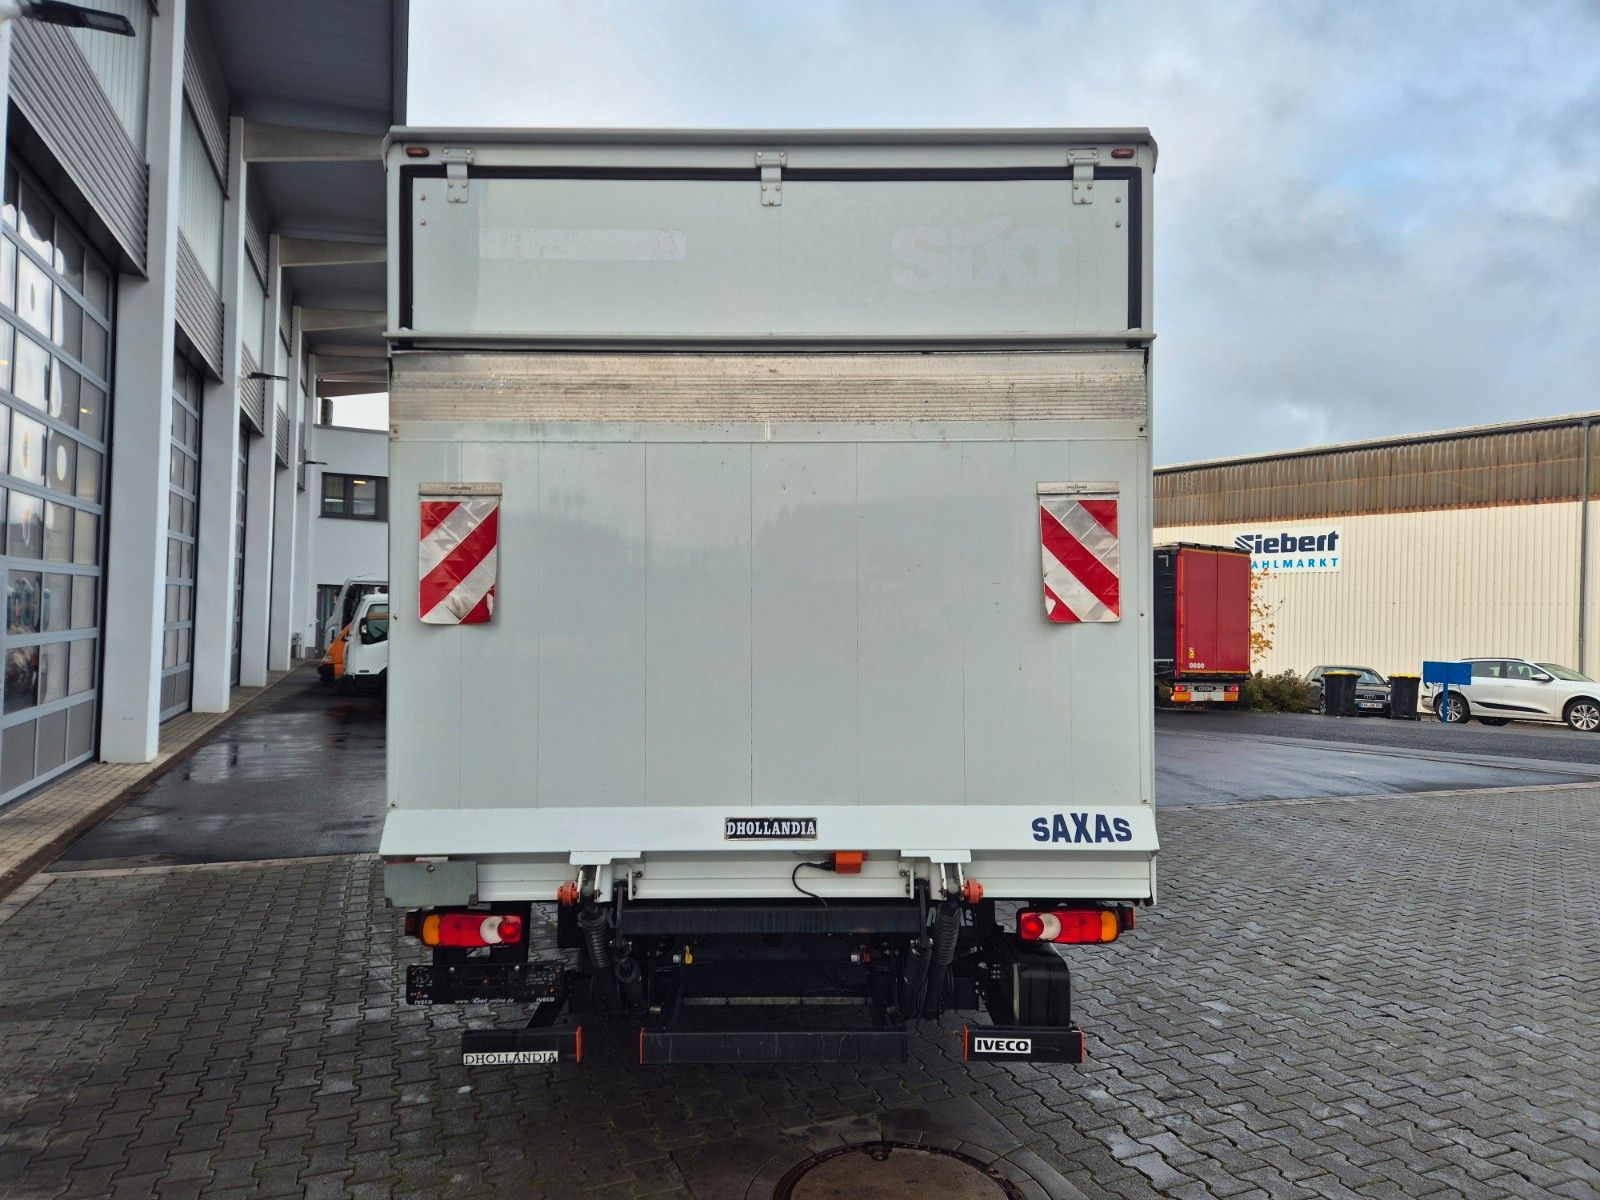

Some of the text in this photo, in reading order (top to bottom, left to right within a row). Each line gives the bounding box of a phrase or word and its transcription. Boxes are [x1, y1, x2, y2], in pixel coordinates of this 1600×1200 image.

[1235, 531, 1339, 554] Siebert
[726, 821, 816, 835] DHOLLANDIA
[1032, 813, 1133, 843] SAXAS
[977, 1040, 1029, 1051] IVECO
[465, 1052, 556, 1065] DHOLLANDIA
